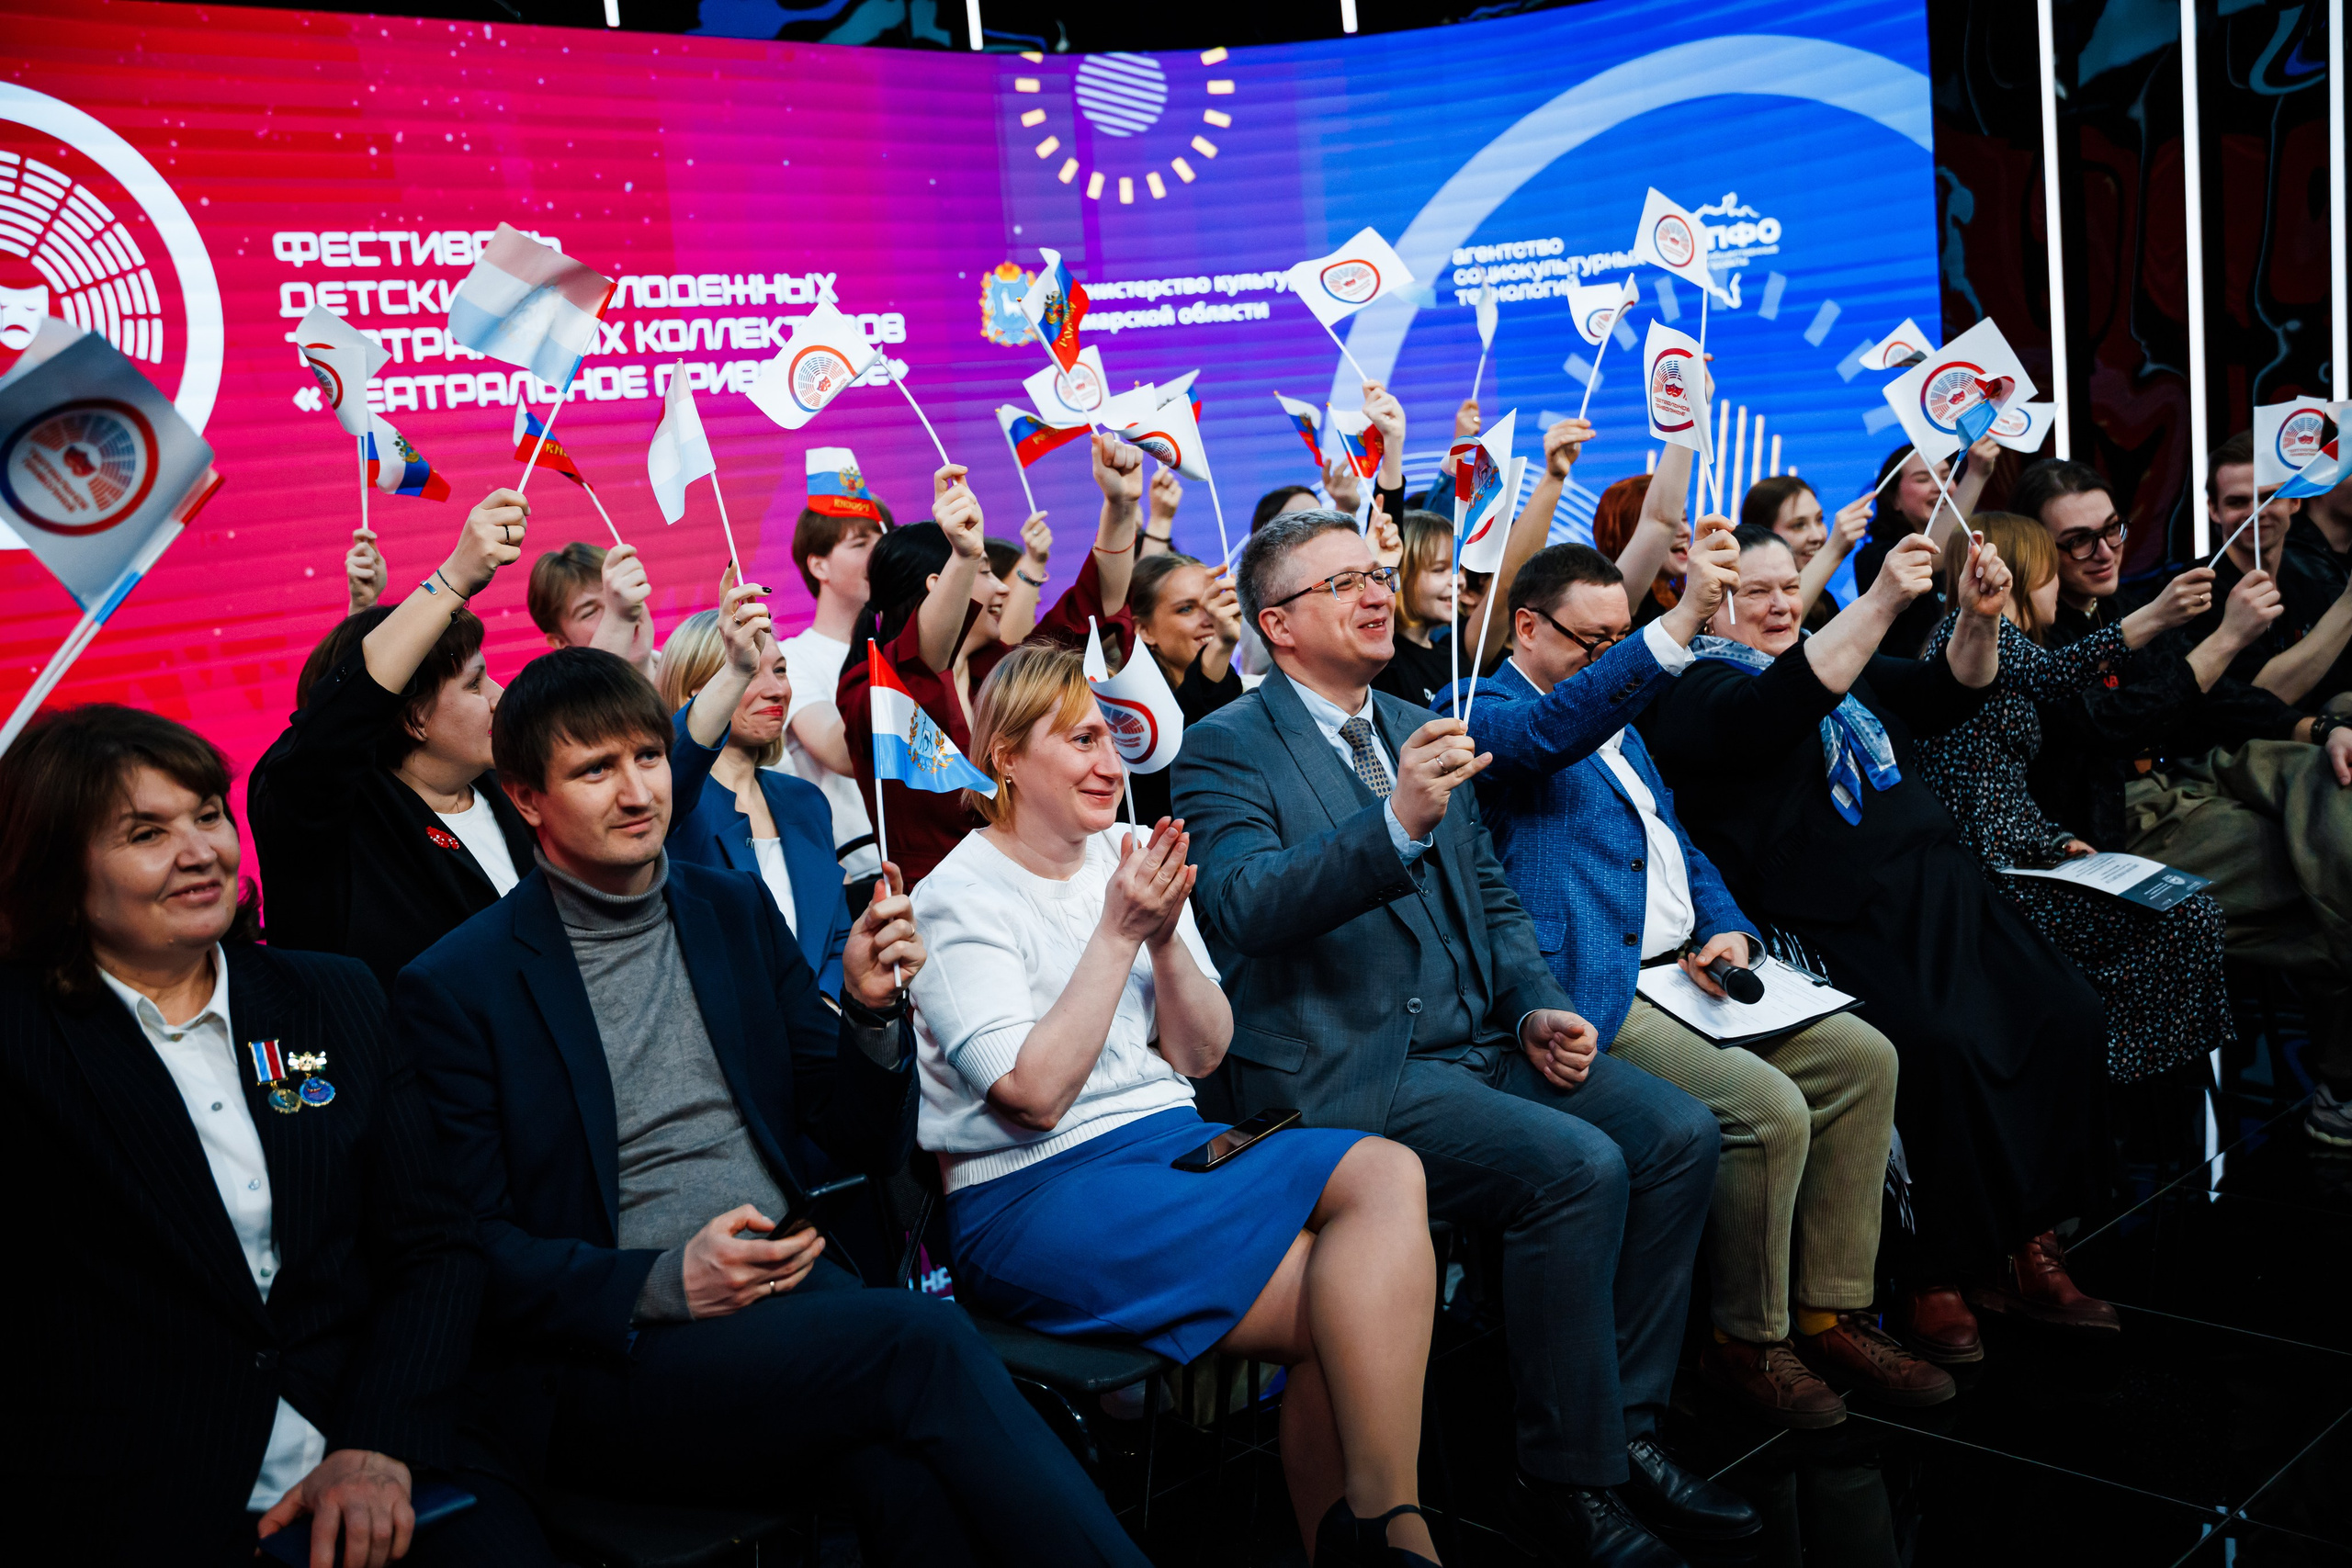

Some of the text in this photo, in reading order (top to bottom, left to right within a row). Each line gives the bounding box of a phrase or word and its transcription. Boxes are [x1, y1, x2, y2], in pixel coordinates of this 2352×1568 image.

[272, 231, 563, 267] ФЕСТИВ
[1452, 237, 1565, 265] агентство
[1706, 217, 1781, 251] ПФО
[279, 272, 840, 317] ДЕТСКИ ЛОДЕЖНЫХ
[1080, 270, 1295, 302] нистерство культу
[1454, 273, 1581, 307] тенологий
[634, 312, 906, 354] КОЛЛЕКТОВ
[1079, 300, 1270, 334] марской области
[293, 365, 649, 413] «ЕАТРАЛЬНОЕ
